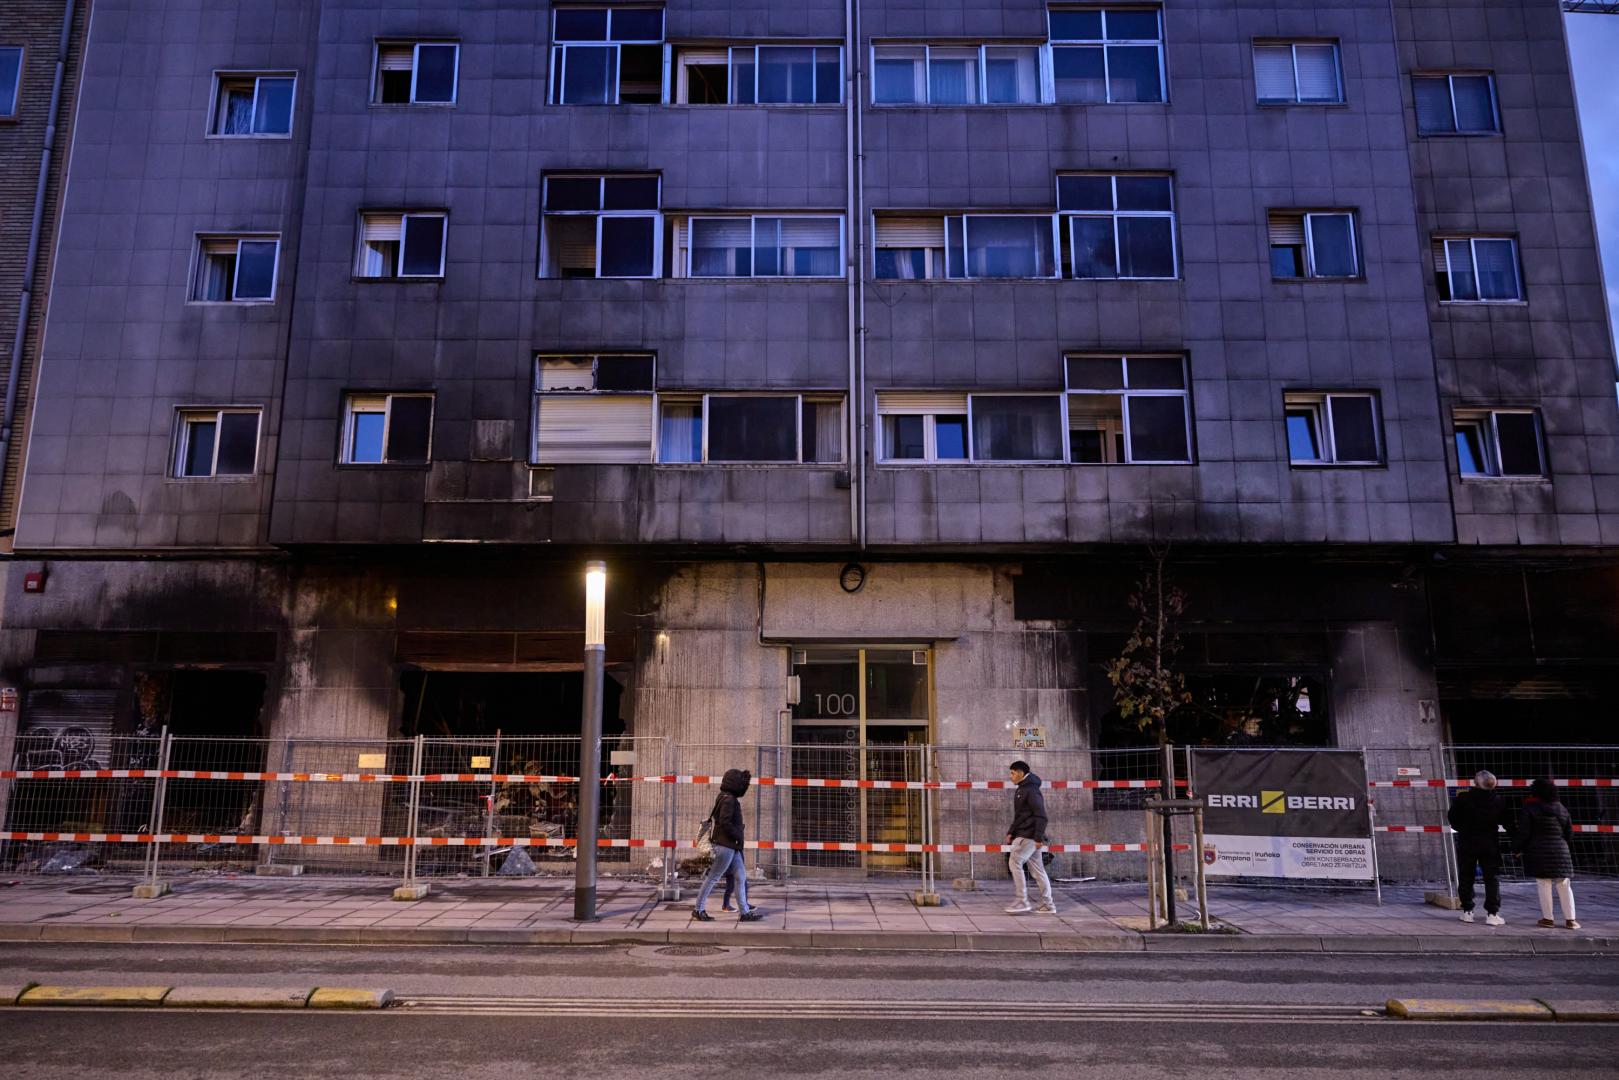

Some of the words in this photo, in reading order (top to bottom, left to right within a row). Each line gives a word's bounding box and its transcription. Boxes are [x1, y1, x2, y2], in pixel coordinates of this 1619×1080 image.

[814, 693, 856, 715] 100
[1207, 794, 1258, 808] ERRI
[1287, 796, 1356, 810] BERRI
[1217, 854, 1251, 862] Pamplona
